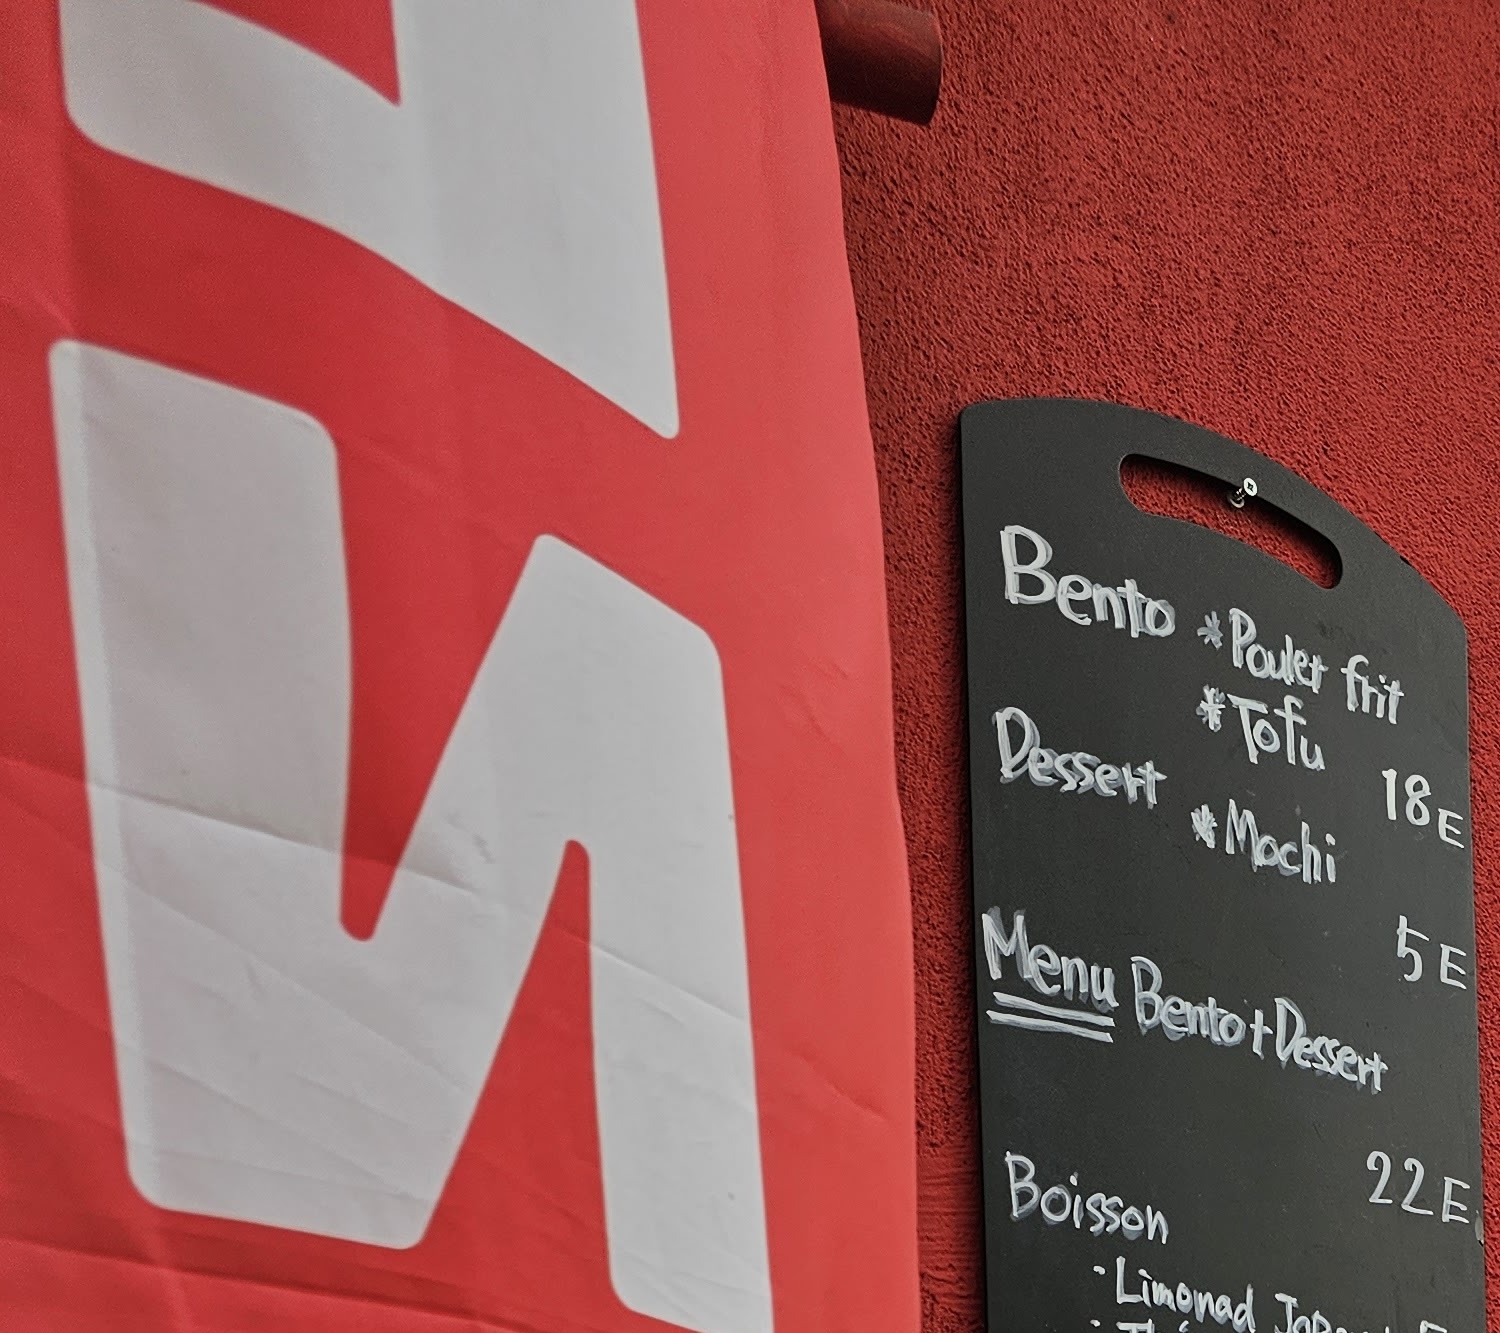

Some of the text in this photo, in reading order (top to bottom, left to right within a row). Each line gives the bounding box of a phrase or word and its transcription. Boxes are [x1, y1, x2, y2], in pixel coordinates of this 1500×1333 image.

[1000, 524, 1404, 724] Bento Poulet frit
[1227, 692, 1325, 771] Tofu
[992, 707, 1337, 884] Dessert Mochi
[982, 906, 1119, 1007] Menu
[1005, 1151, 1169, 1245] Boisson
